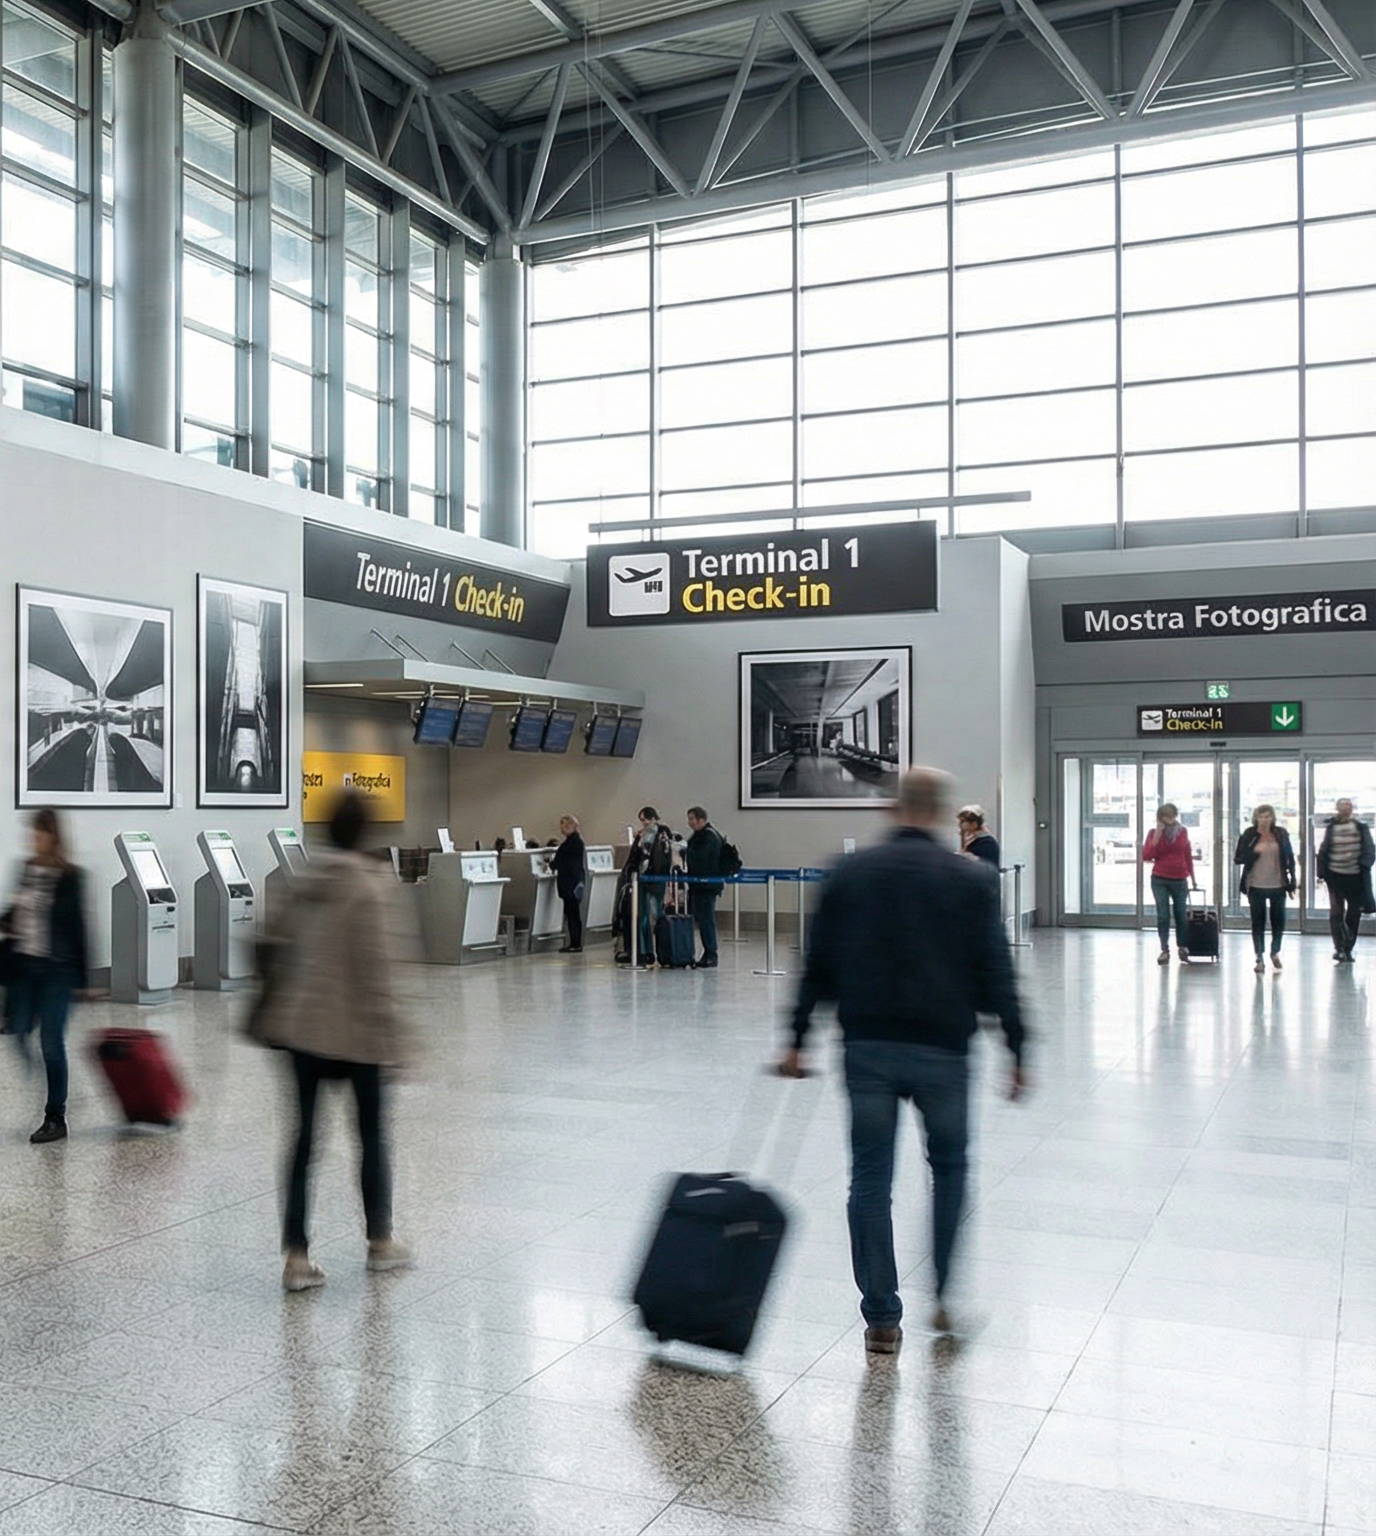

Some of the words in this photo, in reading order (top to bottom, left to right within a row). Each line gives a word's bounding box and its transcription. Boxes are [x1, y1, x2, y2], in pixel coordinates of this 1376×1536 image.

[682, 537, 829, 578] Terminal
[844, 537, 859, 568] 1
[356, 552, 439, 604] Terminal
[442, 572, 451, 607] 1
[454, 575, 525, 623] Check-in
[682, 576, 831, 613] Check-in
[1084, 608, 1184, 634] Mostra
[1195, 598, 1367, 632] Fotografica
[1165, 707, 1213, 719] Terminal
[1216, 707, 1222, 718] 1
